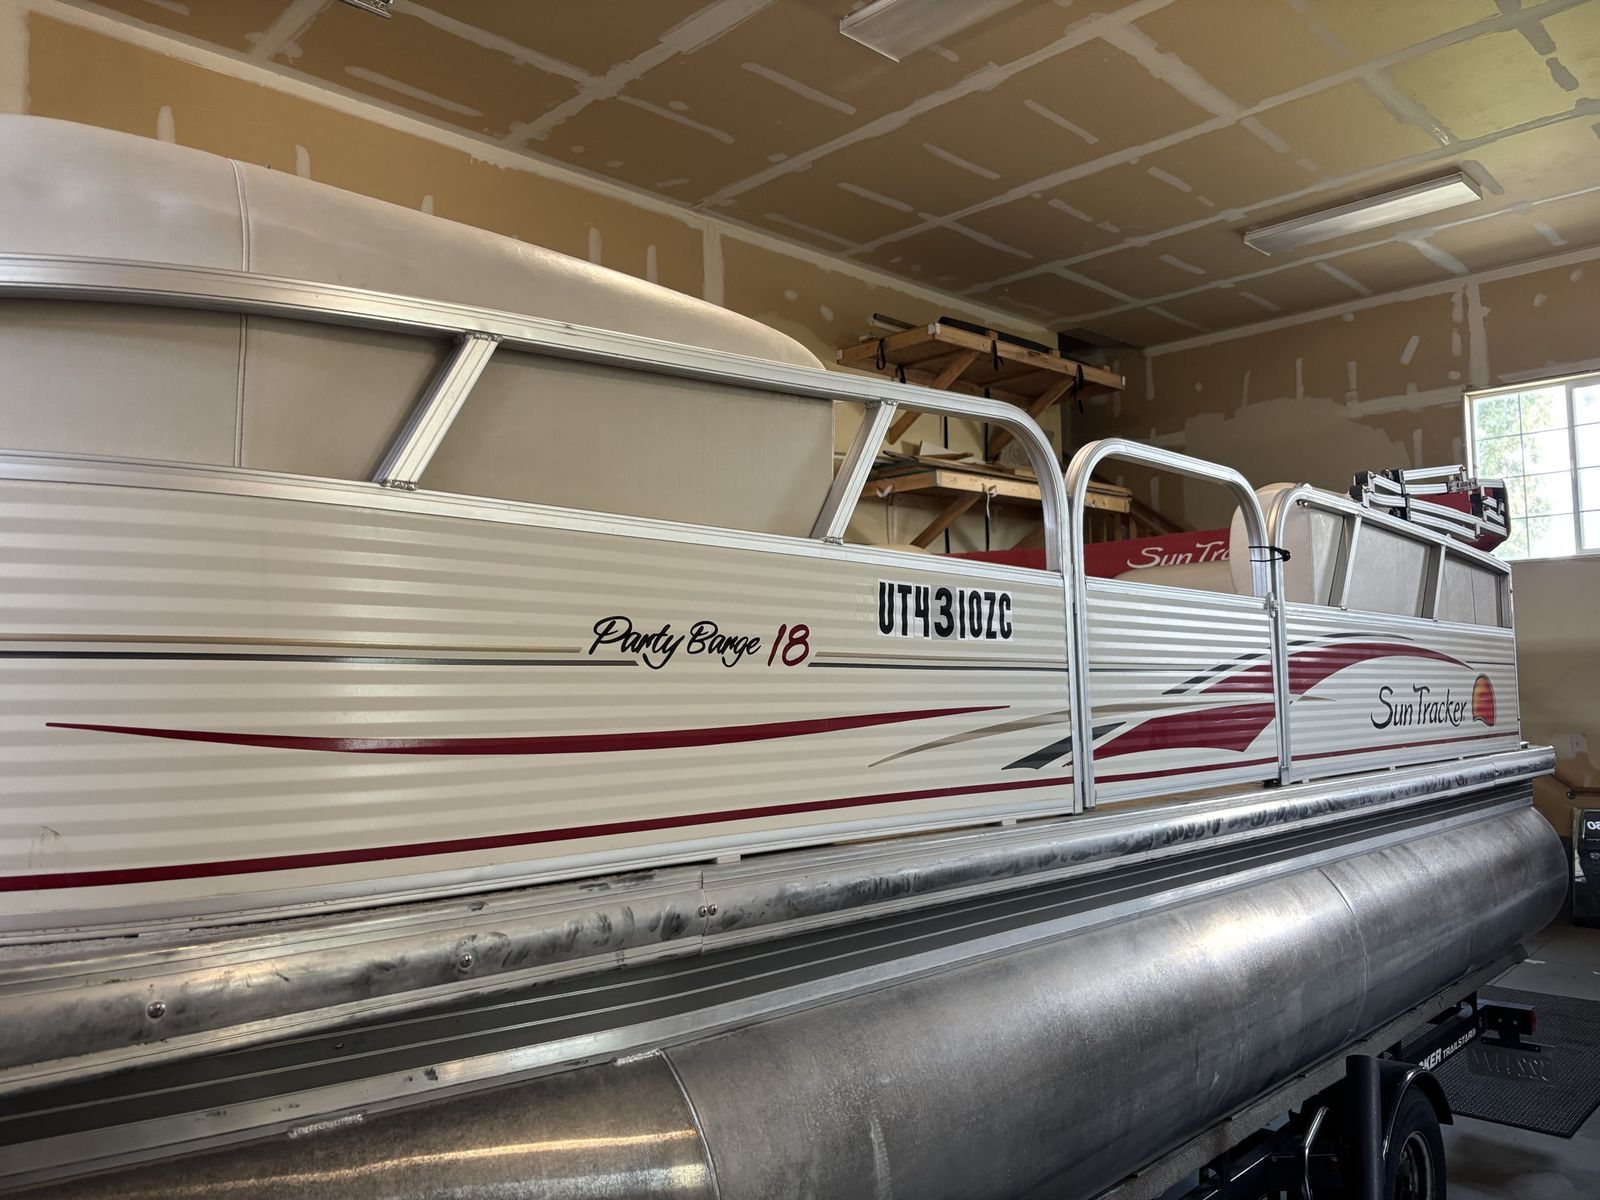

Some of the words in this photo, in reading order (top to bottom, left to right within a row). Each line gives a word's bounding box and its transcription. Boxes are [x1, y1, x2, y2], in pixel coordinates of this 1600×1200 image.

[1126, 546, 1193, 569] Sun
[879, 581, 1013, 640] UT4310ZC
[588, 615, 686, 670] Party
[686, 620, 762, 668] Barge
[767, 623, 810, 667] 18
[1370, 685, 1413, 730] Sun
[1412, 683, 1468, 728] Tracker
